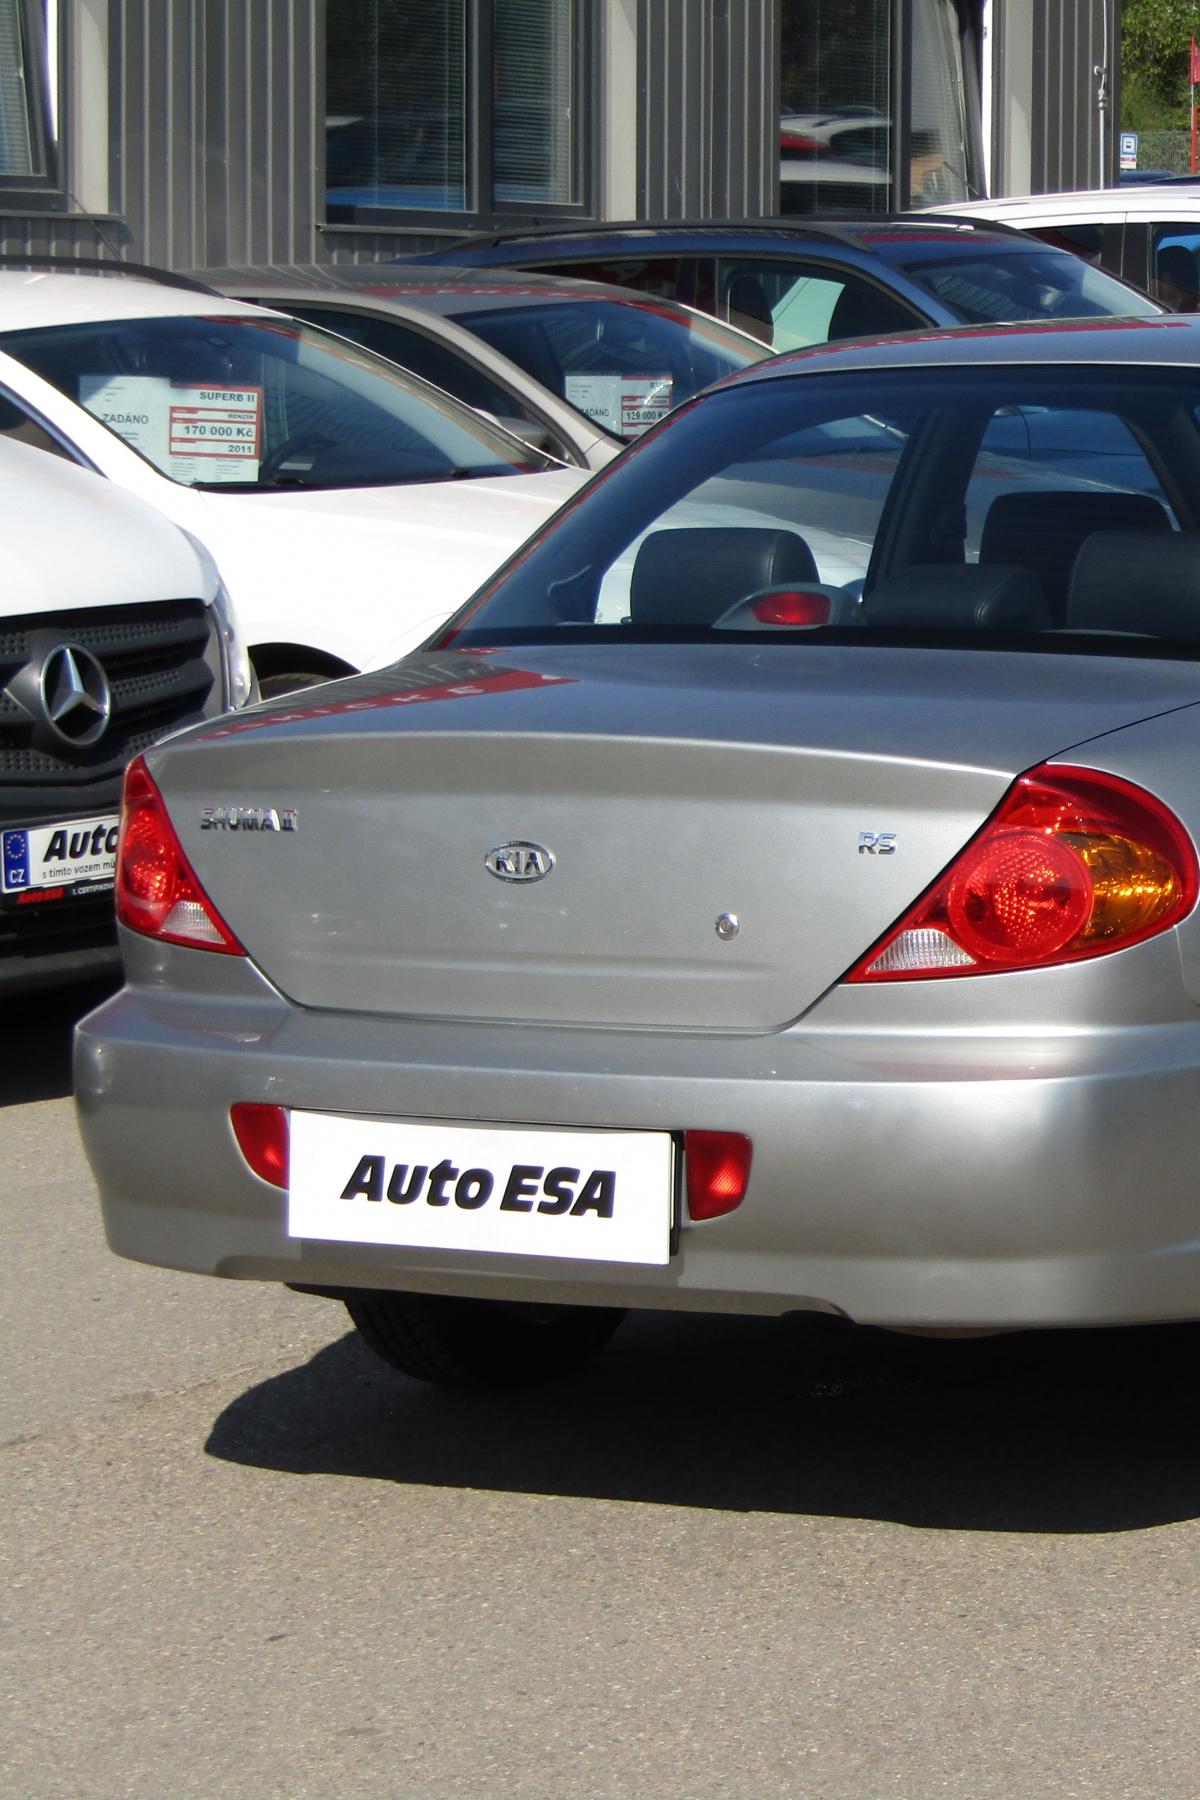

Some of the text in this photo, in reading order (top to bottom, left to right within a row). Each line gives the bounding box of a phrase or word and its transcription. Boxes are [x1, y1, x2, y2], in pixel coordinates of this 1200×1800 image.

[200, 391, 255, 402] SUPERB II
[103, 412, 149, 425] ZADÁNO
[642, 411, 656, 420] 000
[184, 425, 253, 438] 170 000 Kč
[228, 444, 252, 453] 2011
[858, 831, 897, 855] RS
[496, 850, 545, 874] KIA
[10, 869, 25, 884] CZ
[42, 871, 47, 879] s
[74, 863, 101, 874] vozem
[340, 1154, 616, 1218] Auto ESA
